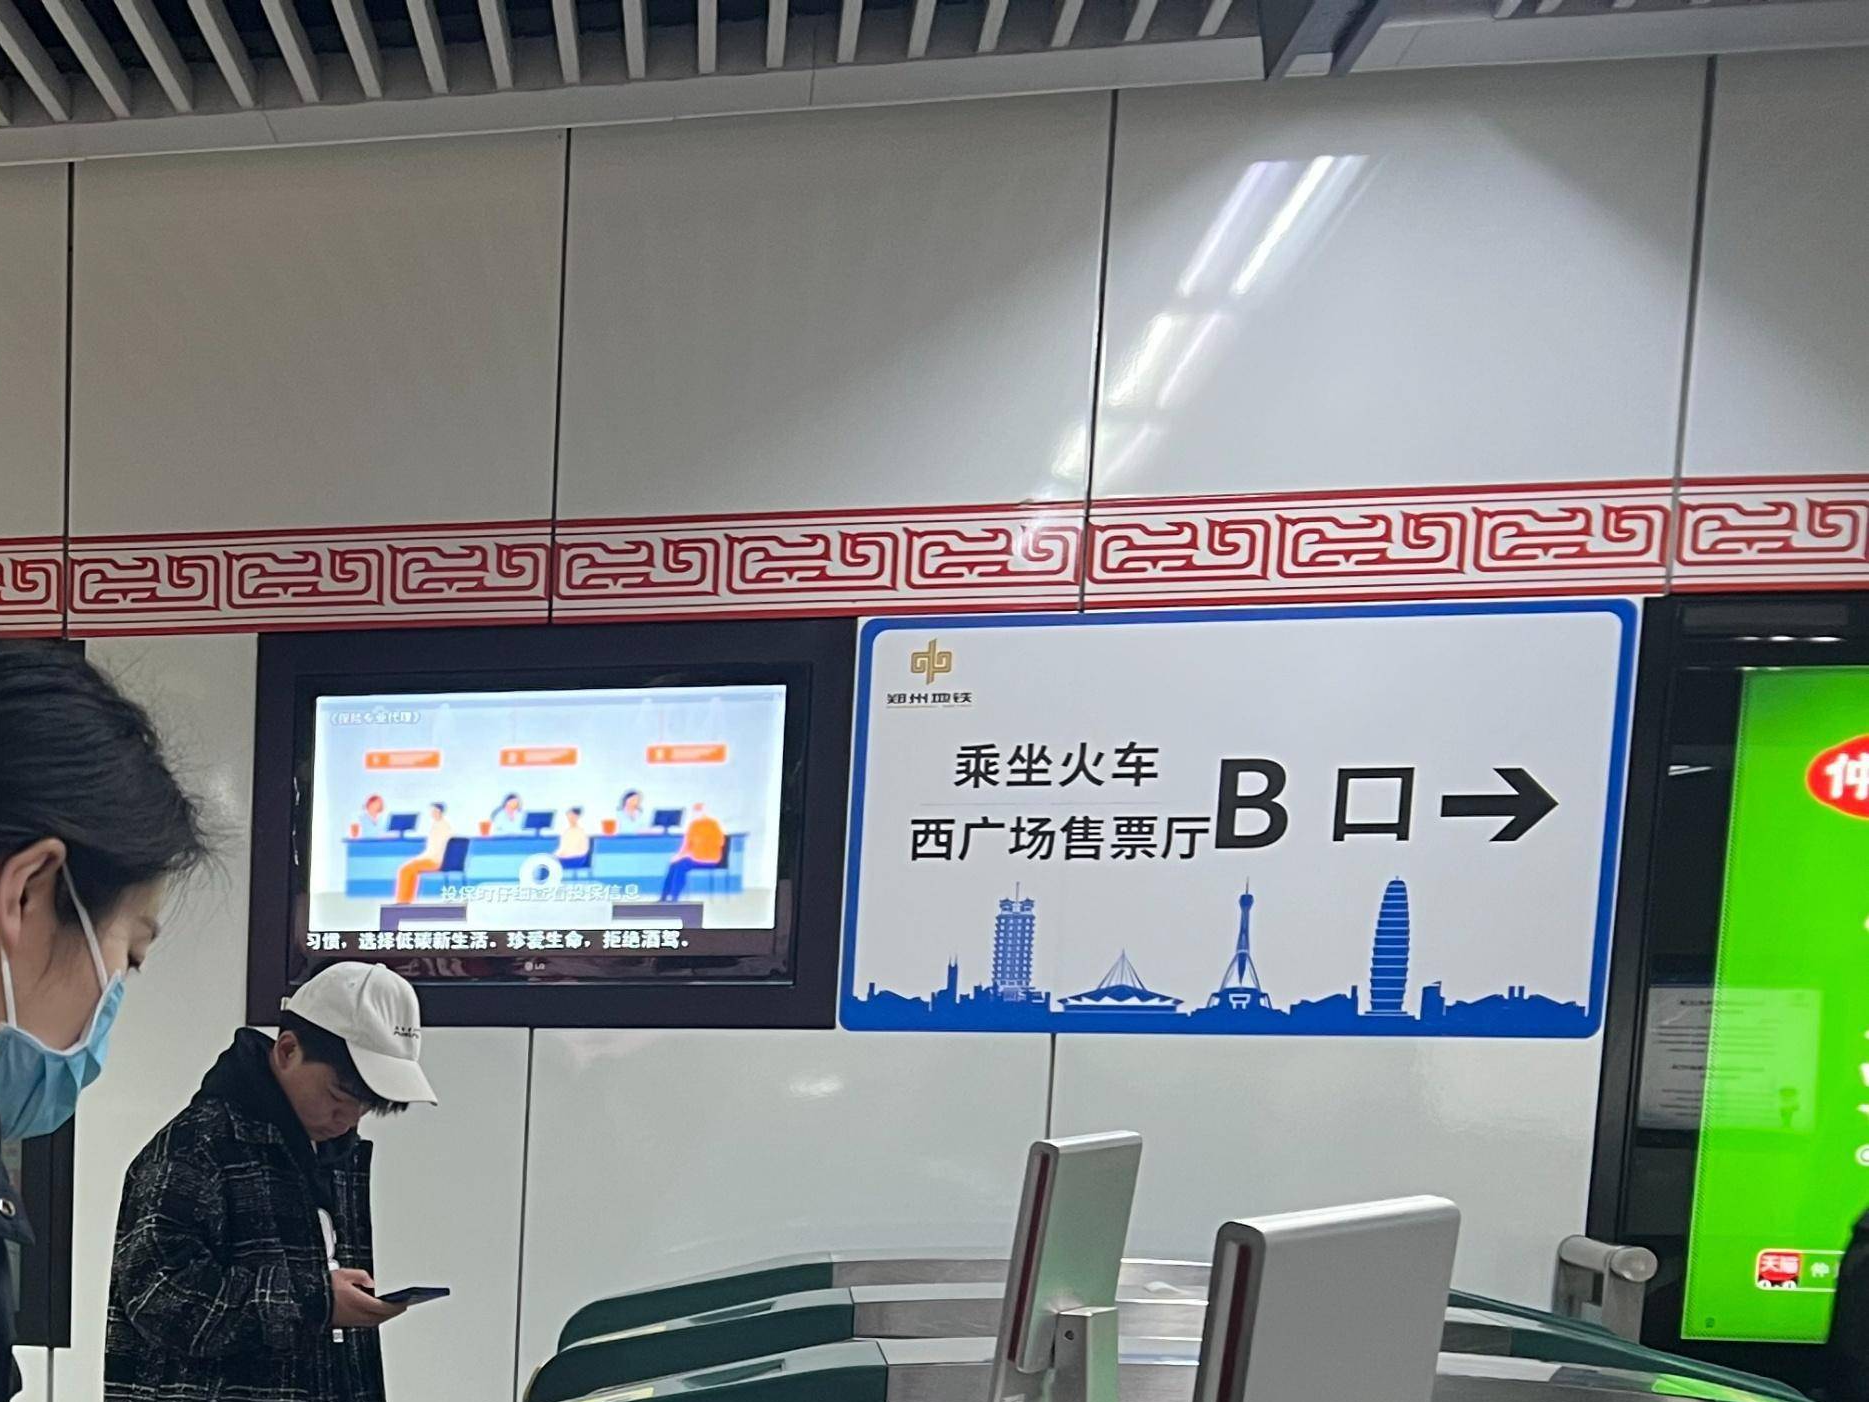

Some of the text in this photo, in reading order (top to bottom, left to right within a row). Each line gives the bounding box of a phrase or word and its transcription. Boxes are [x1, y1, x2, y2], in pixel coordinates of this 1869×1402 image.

[887, 692, 972, 704] 郑州地铁
[953, 740, 1161, 790] 乘坐火车
[1214, 757, 1416, 850] B 口
[909, 815, 1212, 862] 西广场售票厅
